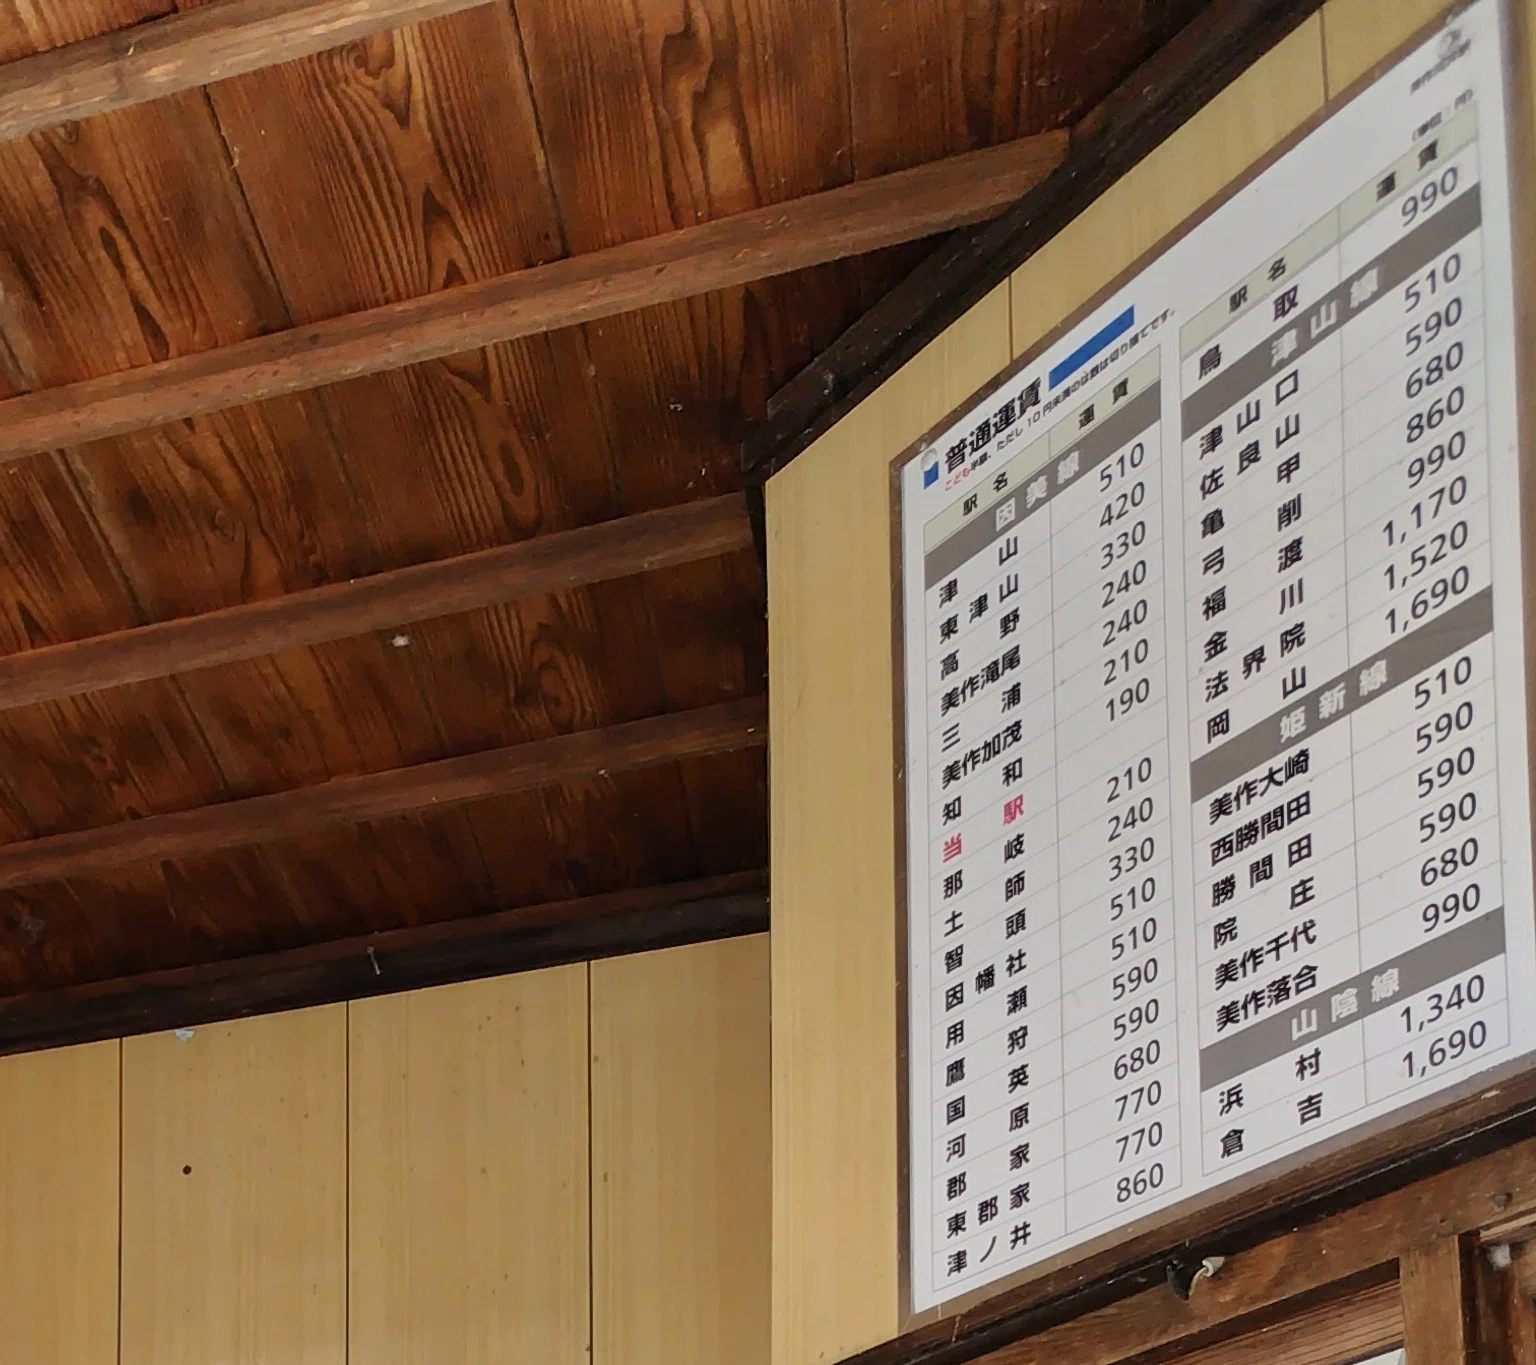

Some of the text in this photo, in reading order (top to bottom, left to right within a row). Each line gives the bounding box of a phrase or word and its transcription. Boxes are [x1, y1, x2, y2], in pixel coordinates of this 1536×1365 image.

[1198, 167, 1458, 380] 鳥取 990
[1229, 257, 1286, 314] 駅名
[1271, 267, 1378, 368] 津山線
[945, 377, 1041, 474] 普通運賃
[1199, 253, 1461, 460] 津山口 510
[1200, 298, 1462, 500] 佐良山 590
[963, 471, 1008, 517] 駅名
[996, 451, 1079, 531] 因美線
[1201, 341, 1464, 539] 亀甲 680
[1202, 385, 1464, 576] 弓削 860
[939, 442, 1144, 608] 津山 510
[939, 482, 1145, 644] 東津山 420
[1202, 430, 1466, 622] 福渡 990
[1204, 475, 1467, 663] 金川 1,170
[940, 521, 1146, 681] 高野 330
[941, 560, 1147, 717] 美作滝尾 240
[1205, 520, 1468, 702] 法界院 1,520
[1207, 565, 1470, 744] 岡山 1,690
[942, 599, 1148, 753] 三浦 240
[942, 639, 1149, 790] 美作加茂 210
[1209, 655, 1472, 826] 美作大崎 510
[1279, 659, 1388, 743] 姫新線
[942, 678, 1149, 826] 知和 190
[1210, 701, 1473, 867] 西勝間田 590
[942, 794, 1024, 863] 当駅
[943, 757, 1152, 900] 那岐 210
[944, 797, 1154, 937] 土師 240
[1212, 746, 1475, 908] 勝間田 590
[1213, 792, 1477, 949] 院庄 590
[944, 837, 1155, 974] 智頭 330
[945, 877, 1156, 1013] 因幡社 510
[1214, 837, 1479, 991] 美作千代 680
[1216, 883, 1481, 1033] 美作落合 990
[945, 917, 1157, 1049] 用瀬 510
[945, 957, 1158, 1087] 鷹狩 590
[1219, 974, 1485, 1117] 浜村 1,340
[1291, 968, 1399, 1041] 山陰線
[946, 998, 1159, 1126] 国英 590
[946, 1039, 1161, 1163] 河原 680
[1220, 1020, 1487, 1159] 倉吉 1,690
[947, 1080, 1162, 1201] 郡家 770
[947, 1121, 1163, 1239] 東郡家 770
[947, 1162, 1164, 1277] 津ノ井 860
